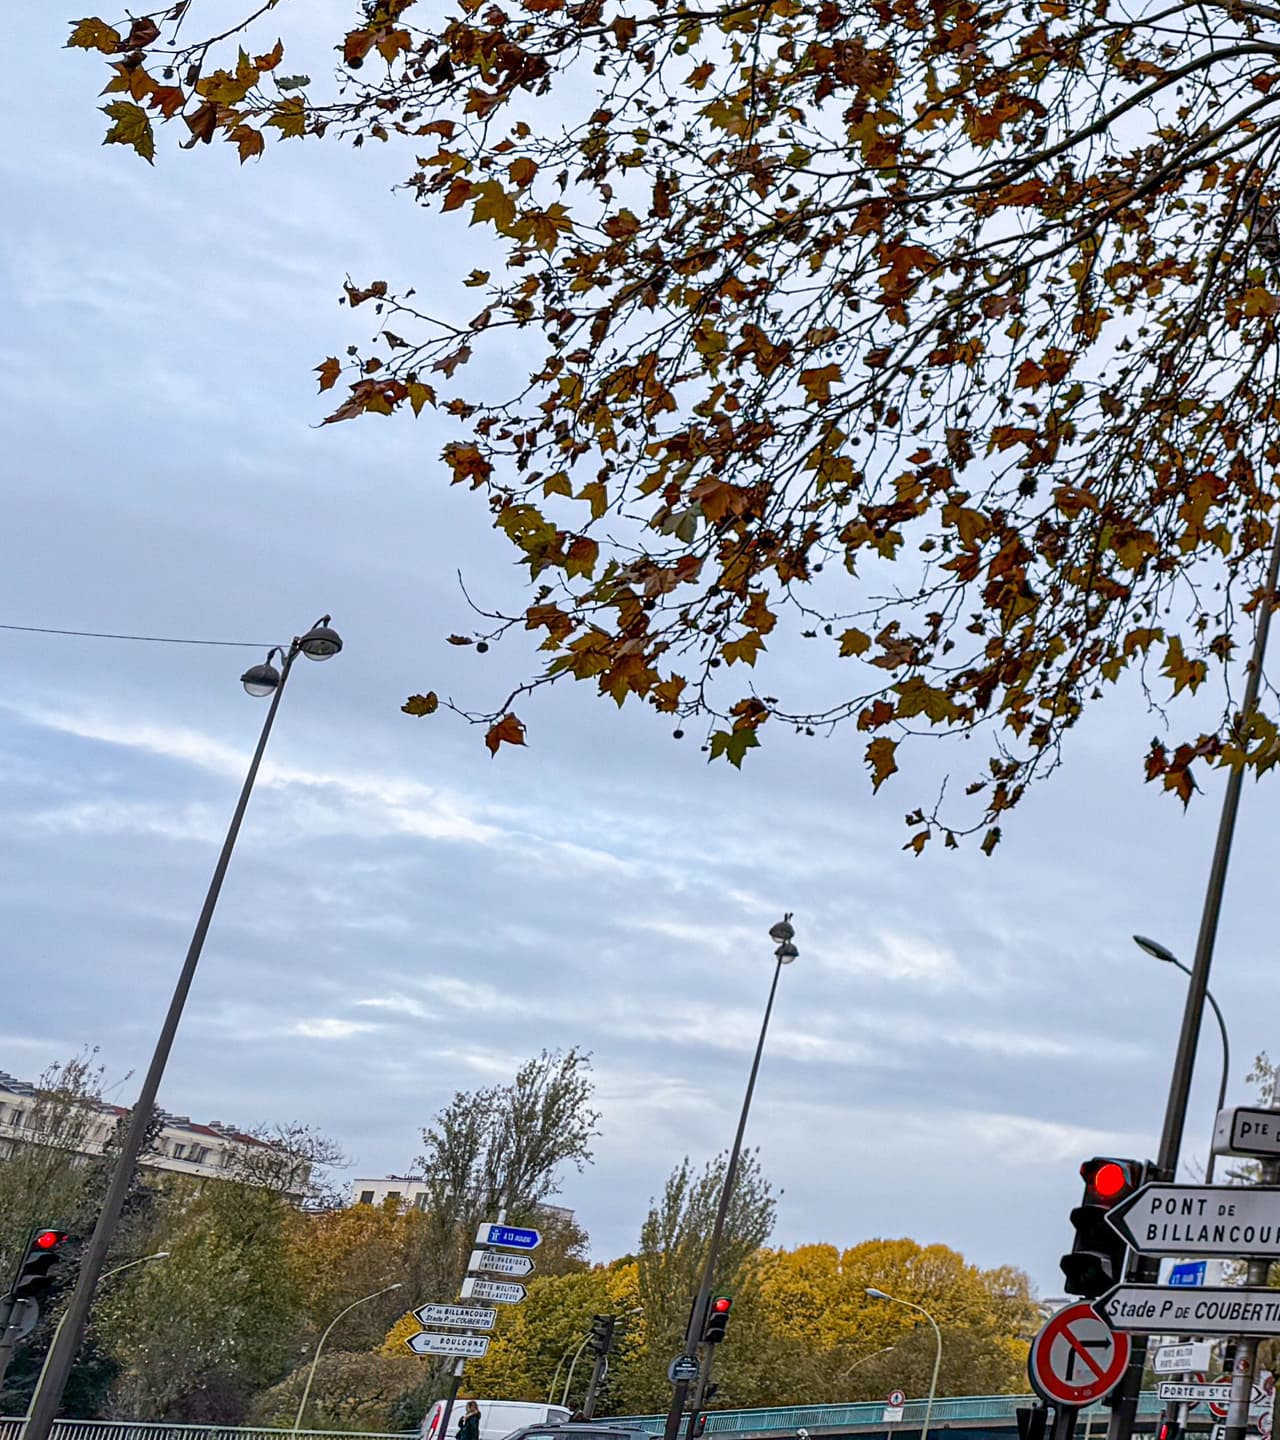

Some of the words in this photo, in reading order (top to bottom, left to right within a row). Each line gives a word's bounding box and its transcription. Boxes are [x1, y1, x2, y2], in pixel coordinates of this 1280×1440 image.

[1239, 1121, 1269, 1139] PTE
[1150, 1198, 1207, 1217] PONT
[1218, 1205, 1236, 1217] DE
[444, 1308, 493, 1318] BILLANCOURT
[1108, 1298, 1156, 1319] Stade
[1159, 1300, 1173, 1317] P
[1175, 1307, 1190, 1319] DE
[440, 1337, 485, 1347] BOULOGNE
[1163, 1386, 1194, 1397] PORTE
